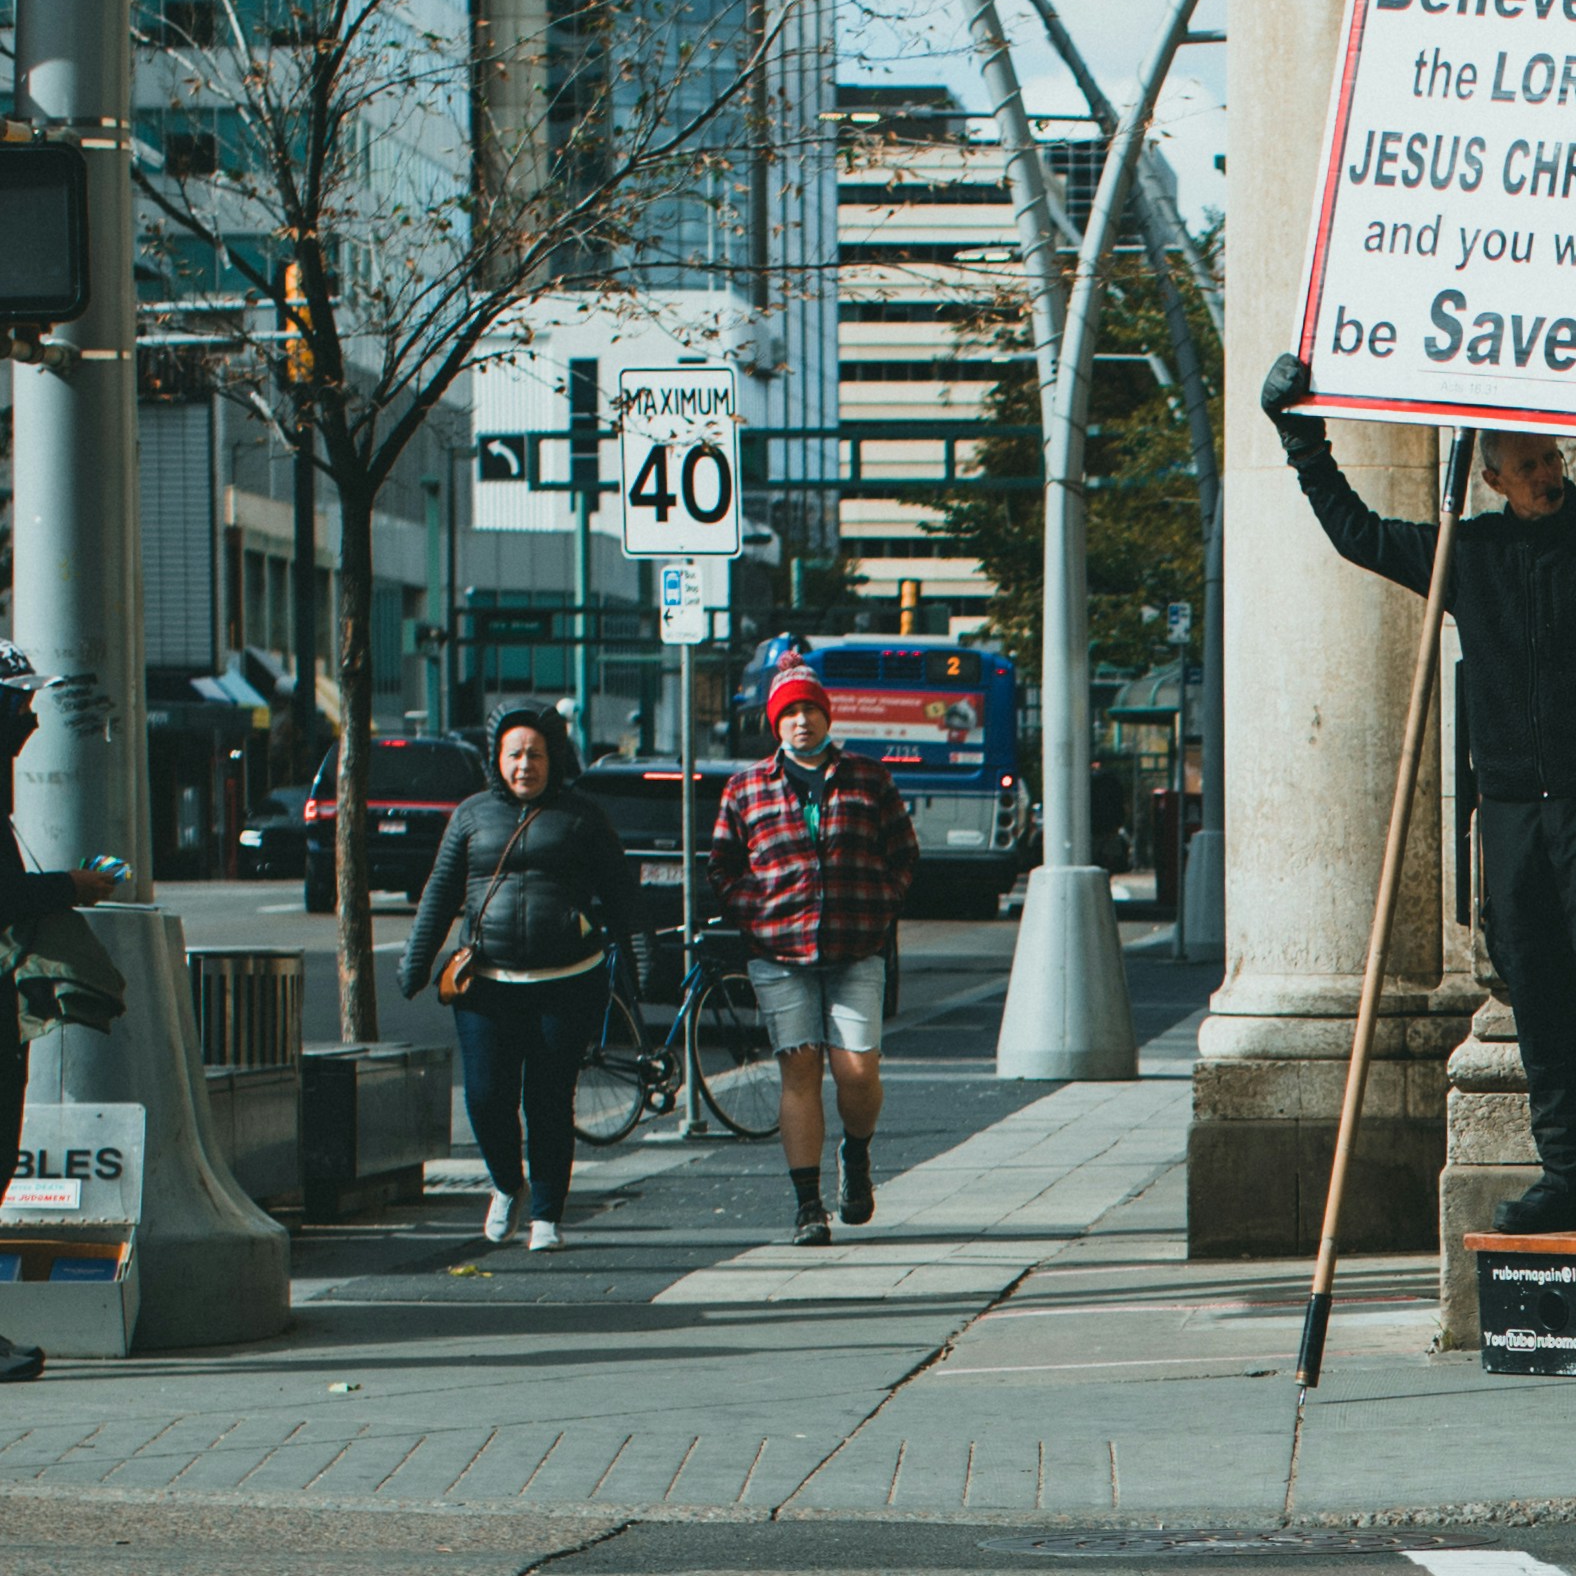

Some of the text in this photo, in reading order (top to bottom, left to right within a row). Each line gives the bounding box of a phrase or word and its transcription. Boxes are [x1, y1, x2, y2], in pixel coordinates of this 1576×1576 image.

[1412, 47, 1478, 101] the
[1348, 129, 1487, 194] JESUS
[1363, 214, 1443, 256] and
[1454, 226, 1535, 271] you
[1331, 305, 1398, 358] be
[625, 387, 730, 415] MAXIMUM
[628, 443, 732, 524] 40
[947, 655, 961, 676] 2
